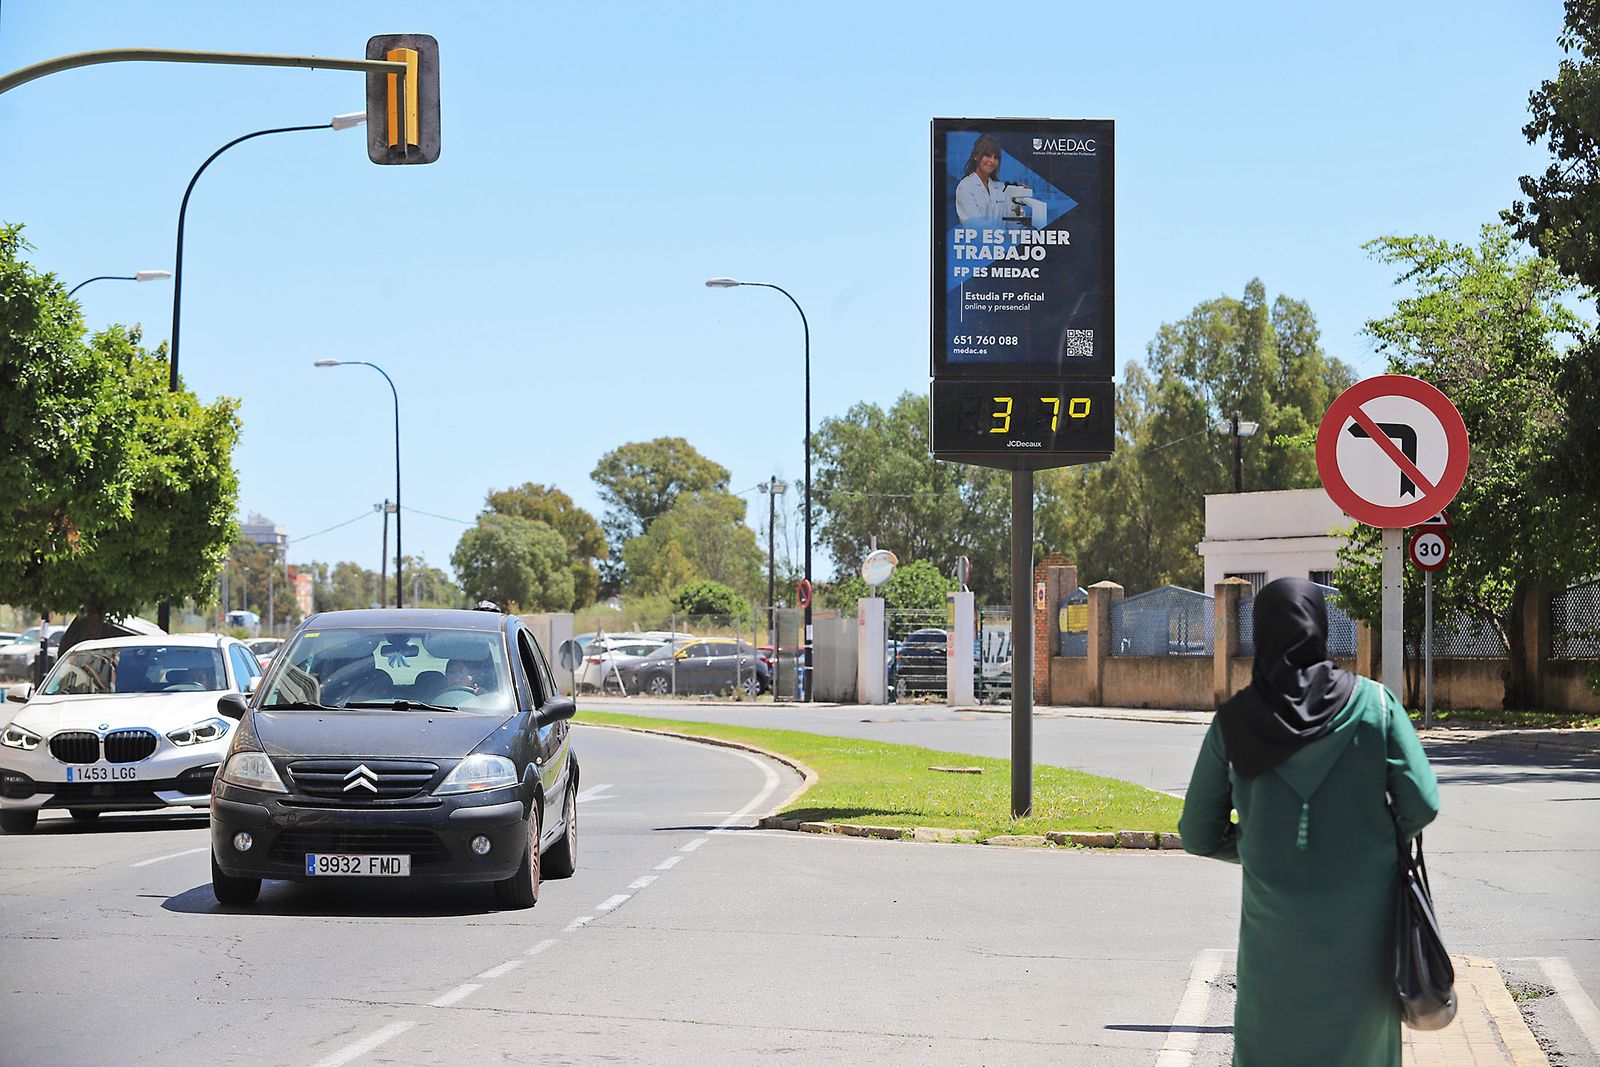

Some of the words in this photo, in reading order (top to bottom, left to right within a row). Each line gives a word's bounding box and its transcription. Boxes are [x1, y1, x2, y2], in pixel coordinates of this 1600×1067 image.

[1043, 138, 1096, 152] MEDAC
[954, 228, 978, 244] FP
[982, 229, 1005, 245] ES
[1008, 229, 1071, 246] TENER
[953, 245, 1047, 261] TRABAJO
[953, 266, 970, 277] FP
[972, 266, 988, 278] ES
[991, 267, 1040, 279] MEDAC
[965, 291, 1000, 301] Estudia
[1002, 292, 1015, 301] FP
[1017, 292, 1045, 301] oficial
[987, 304, 993, 312] y
[994, 303, 1031, 313] presencial
[953, 335, 972, 345] 651
[976, 335, 996, 345] 760
[998, 336, 1019, 346] 088
[1006, 440, 1042, 448] JCDecaux
[1419, 542, 1441, 557] 30
[78, 767, 108, 780] 1453
[111, 767, 136, 780] LGG
[319, 856, 362, 874] 9932
[369, 857, 401, 874] FMD
